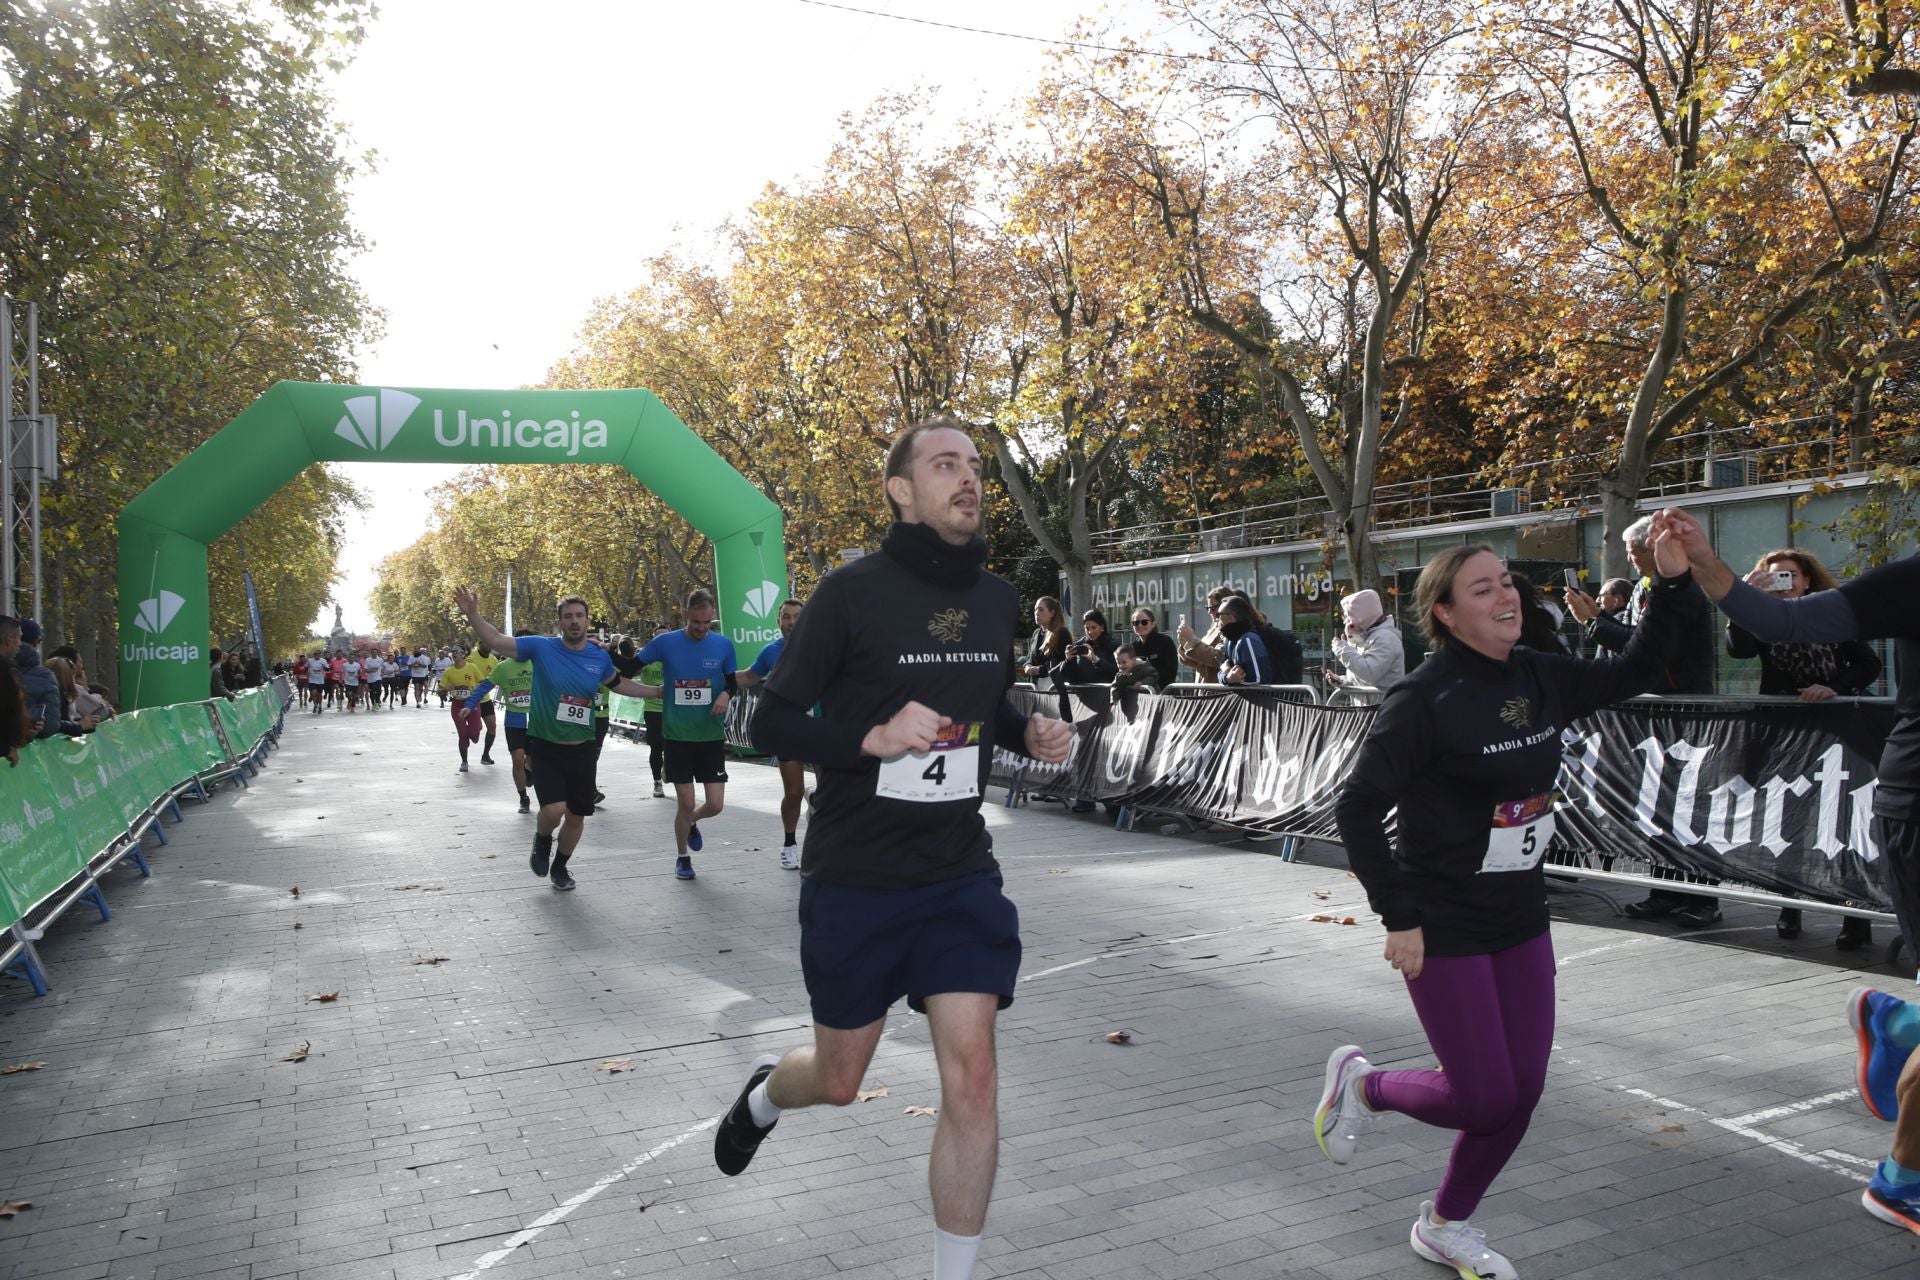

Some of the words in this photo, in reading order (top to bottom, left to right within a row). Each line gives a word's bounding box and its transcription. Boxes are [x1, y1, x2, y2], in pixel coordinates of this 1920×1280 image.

[434, 409, 607, 456] Unicaja
[1266, 565, 1333, 601] amiga
[733, 626, 782, 643] Unica
[124, 641, 199, 664] Unicaja
[898, 653, 941, 664] ABADIA
[945, 653, 1000, 662] RETUERTA
[512, 696, 530, 704] 446
[684, 689, 701, 700] 99
[568, 706, 584, 718] 98
[1483, 739, 1523, 754] ABADIA
[1525, 725, 1556, 746] RETUA
[922, 755, 947, 785] 4
[1521, 824, 1536, 856] 5
